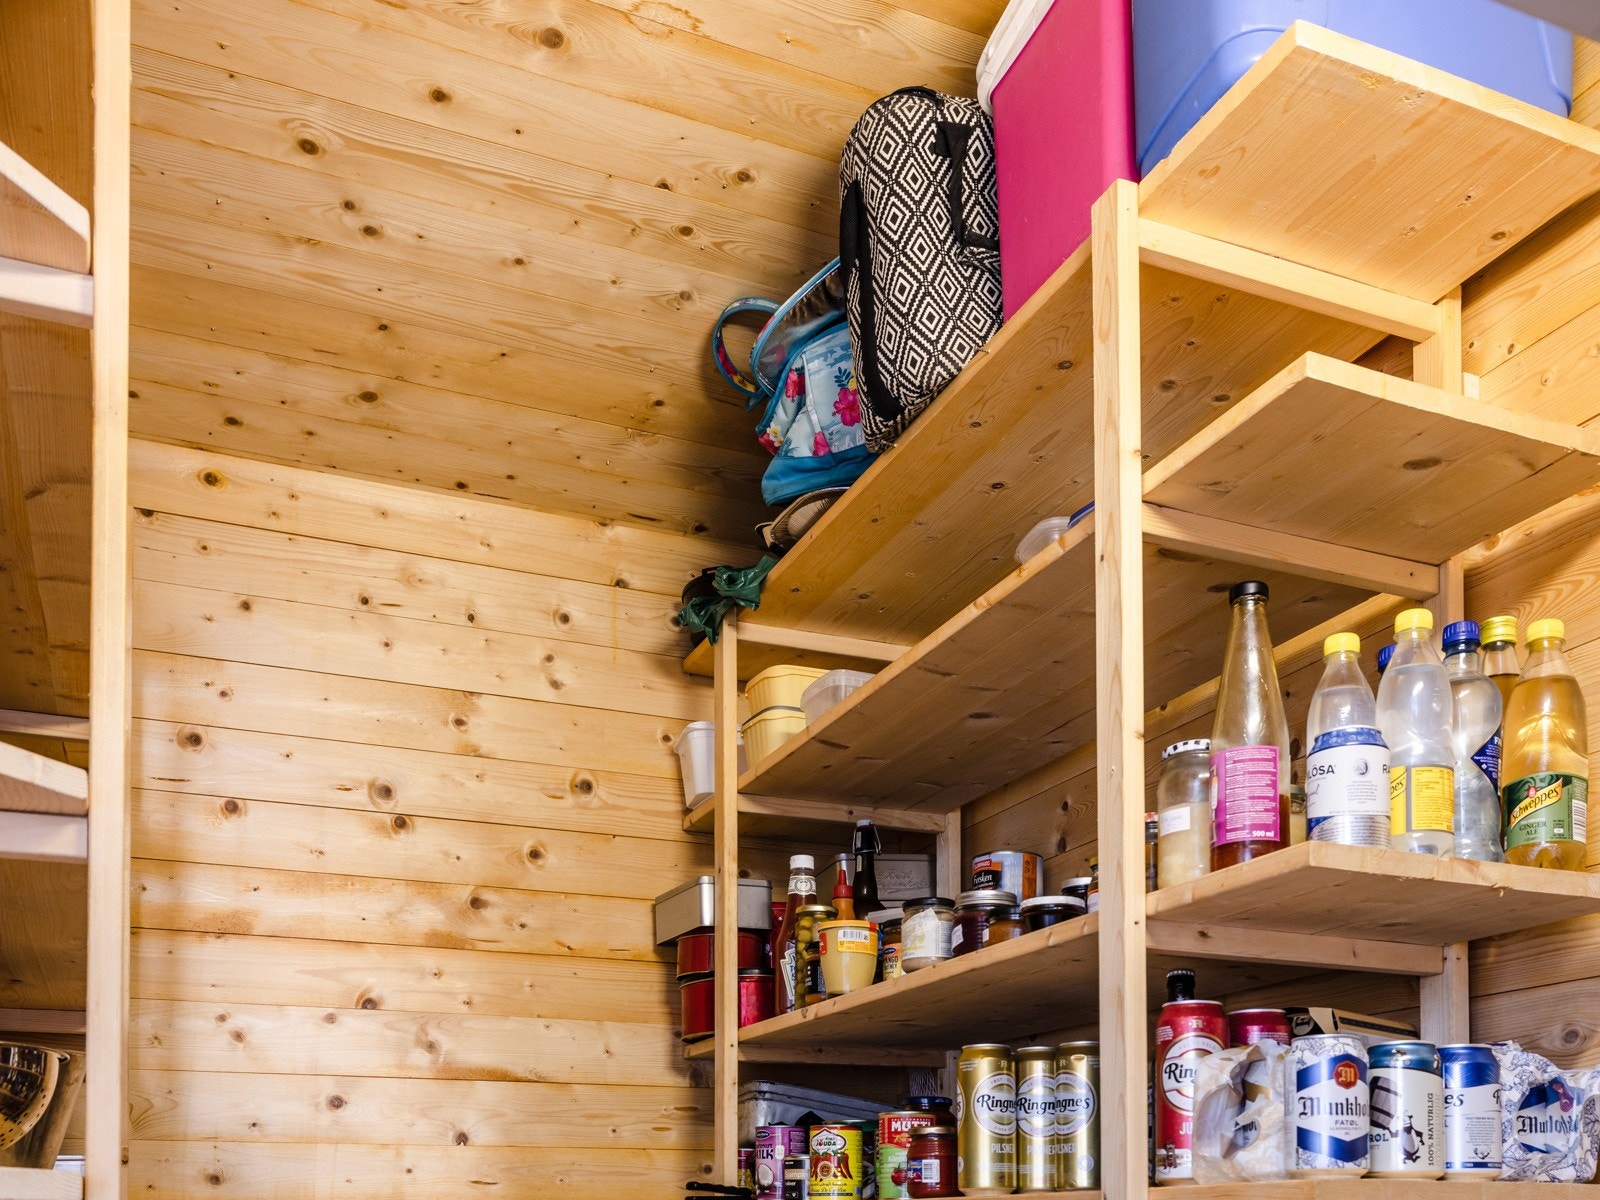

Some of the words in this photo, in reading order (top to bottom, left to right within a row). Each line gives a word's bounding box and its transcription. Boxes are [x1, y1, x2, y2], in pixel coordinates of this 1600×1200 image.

[1512, 784, 1561, 821] Schweppes
[1519, 820, 1547, 832] GINGER
[1252, 830, 1266, 838] 500
[1266, 830, 1275, 838] ml
[1525, 829, 1539, 837] ALE
[1427, 1092, 1435, 1140] NATURLIG
